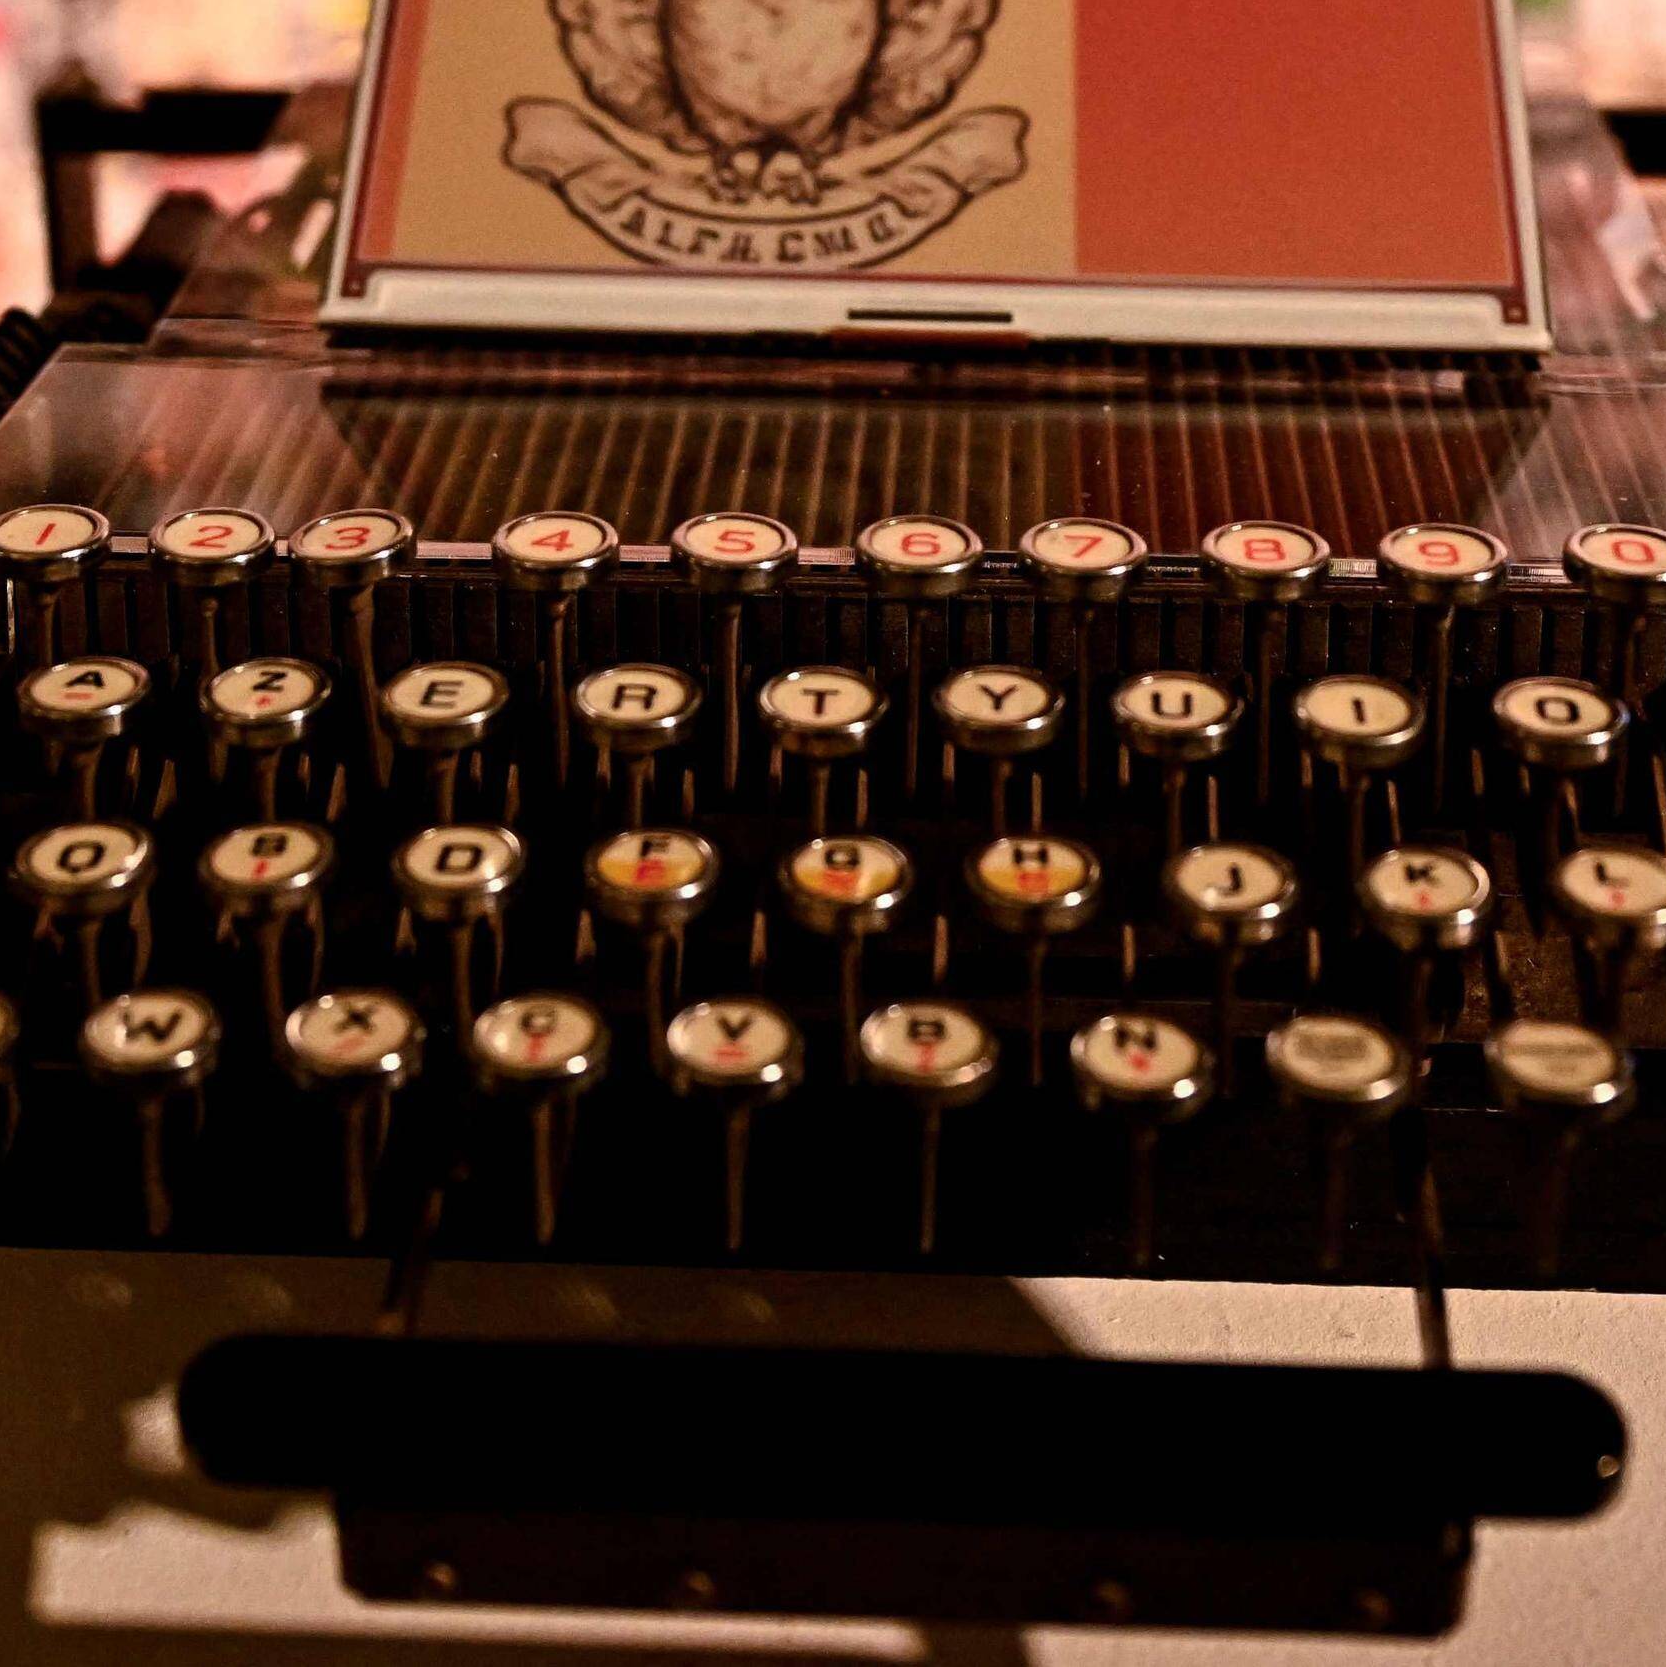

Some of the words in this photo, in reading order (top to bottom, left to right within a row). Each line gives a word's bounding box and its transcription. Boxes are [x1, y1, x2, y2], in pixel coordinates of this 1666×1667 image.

[36, 523, 55, 545] 1
[190, 526, 233, 548] 2
[326, 527, 371, 551] 3
[531, 529, 573, 552] 4
[713, 531, 755, 554] 5
[900, 533, 941, 557] 6
[1064, 535, 1103, 559] 7
[1243, 538, 1286, 562] 8
[1418, 540, 1460, 567] 9
[66, 671, 105, 687] A
[254, 672, 286, 691] Z
[421, 680, 465, 708] E
[612, 684, 657, 709] R
[802, 688, 840, 716] T
[980, 683, 1017, 710] Y
[1151, 691, 1193, 719] U
[1013, 844, 1050, 866] H
[337, 1002, 373, 1032] X
[716, 1014, 753, 1040] V
